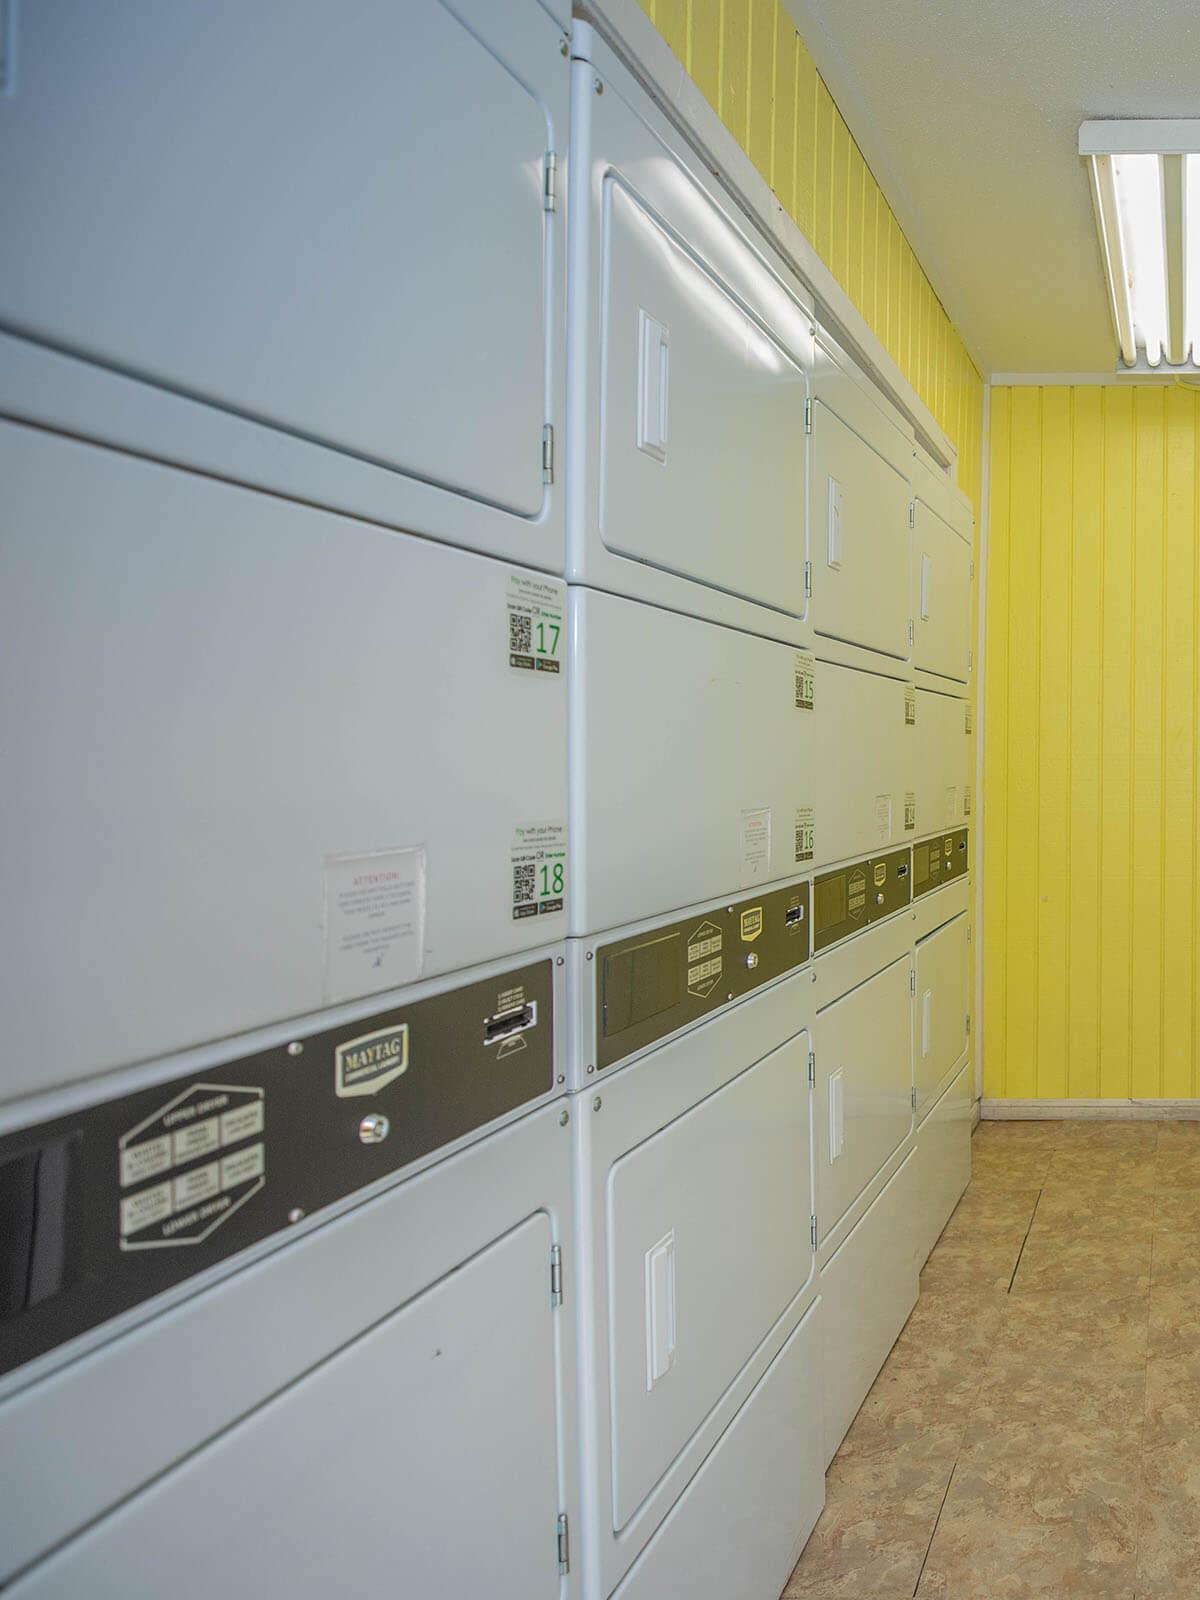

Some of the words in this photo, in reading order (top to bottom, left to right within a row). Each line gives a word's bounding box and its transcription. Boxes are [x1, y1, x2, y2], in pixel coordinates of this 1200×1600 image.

[536, 622, 560, 655] 17
[805, 830, 814, 849] 16
[540, 863, 564, 896] 18
[346, 1038, 401, 1072] MAYTAG
